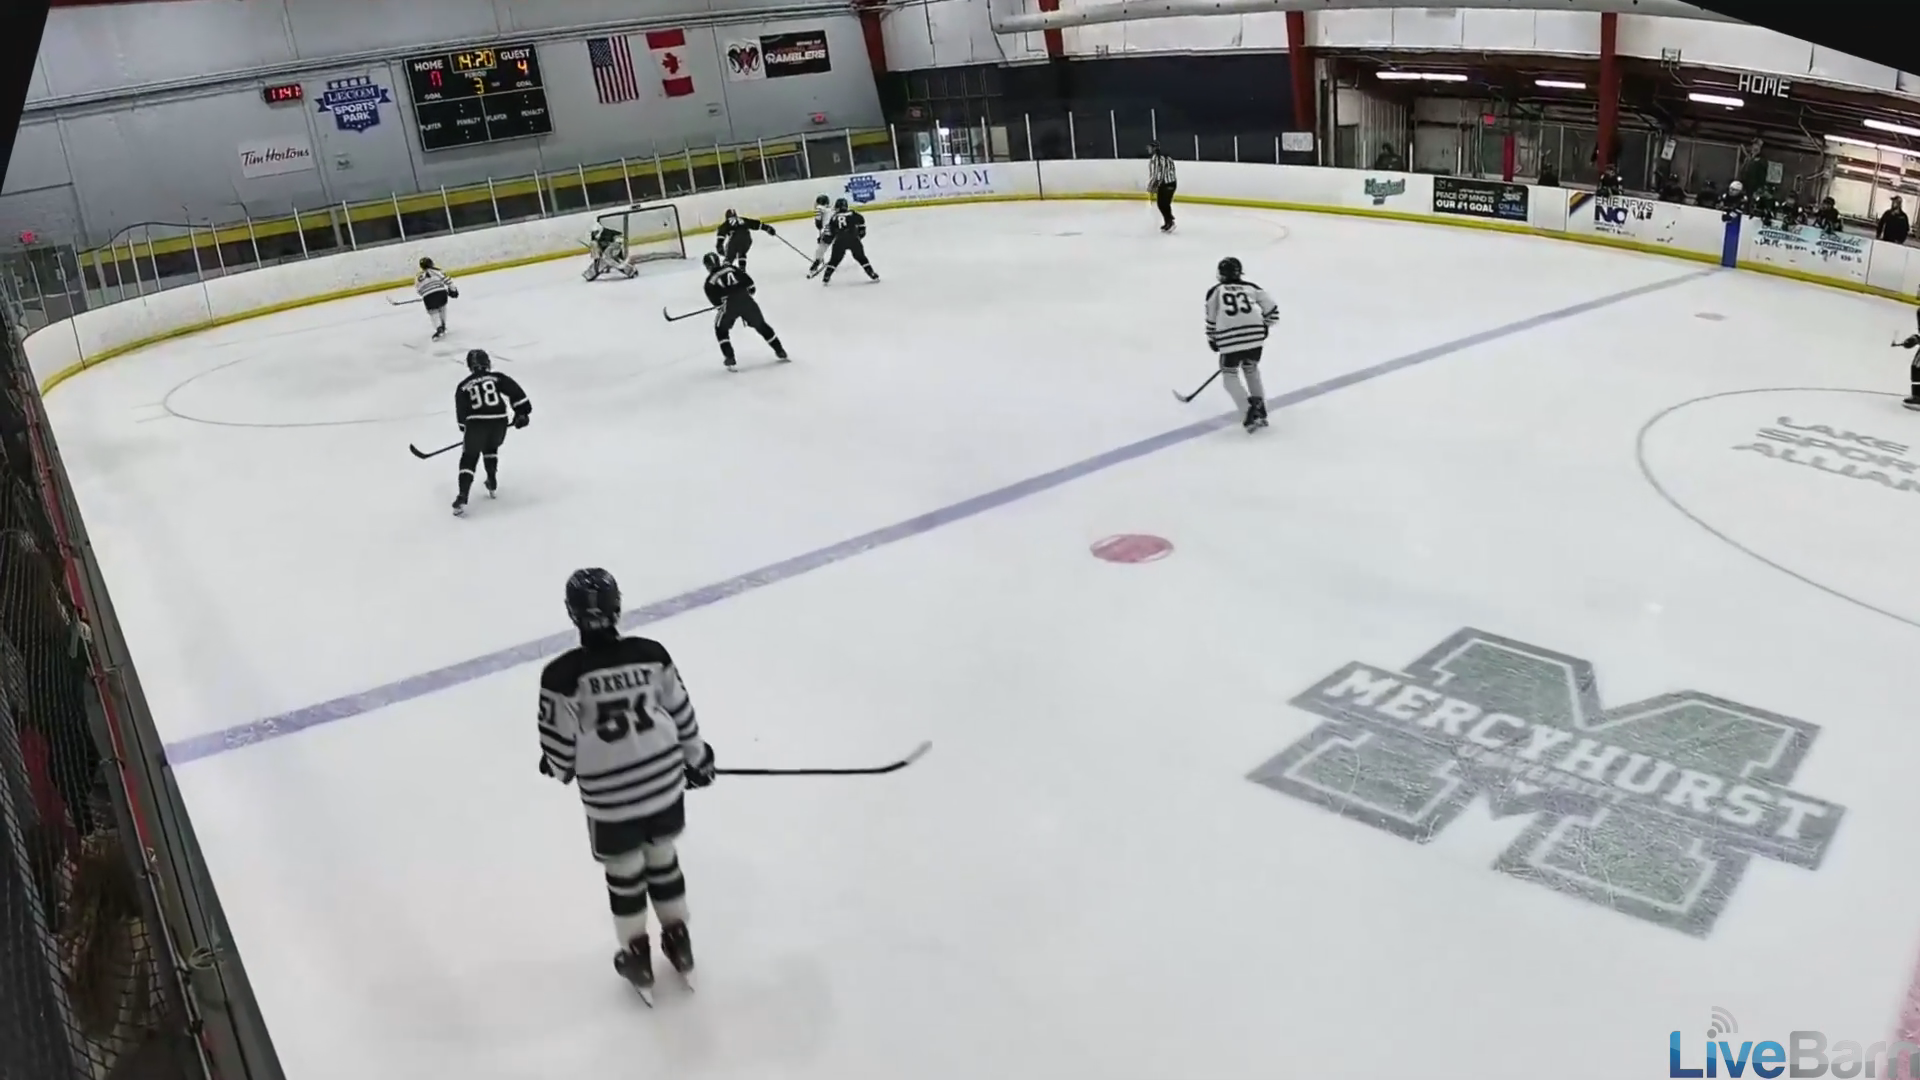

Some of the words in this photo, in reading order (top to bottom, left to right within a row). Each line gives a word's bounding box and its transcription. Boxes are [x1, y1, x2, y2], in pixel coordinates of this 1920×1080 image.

[500, 49, 531, 60] GUEST
[765, 50, 826, 65] RAMBLERS
[414, 60, 444, 72] HOME
[517, 60, 528, 75] 4
[464, 70, 487, 79] PERIOD
[473, 77, 485, 94] 3
[516, 80, 533, 88] GOAL
[1738, 74, 1791, 98] HOME
[326, 87, 376, 102] LECOM
[424, 92, 443, 100] GOAL
[335, 102, 375, 115] SPORTS
[343, 111, 371, 123] PARK
[240, 150, 264, 166] Tim
[265, 147, 310, 162] Hortons
[898, 169, 990, 191] LECOM
[1435, 191, 1457, 200] PEACE
[1458, 193, 1468, 201] OF
[1469, 194, 1487, 203] MIND
[1595, 196, 1620, 208] ERIE
[1621, 199, 1654, 212] NEWS
[1435, 199, 1456, 209] OUR
[1457, 201, 1468, 210] #1
[1469, 202, 1494, 213] GOAL
[1223, 292, 1252, 317] 93
[467, 381, 500, 410] 98
[1777, 416, 1909, 456] LAKE
[1756, 428, 1920, 475] SPOR
[596, 693, 655, 743] 51
[1322, 667, 1827, 839] MERCYHURST
